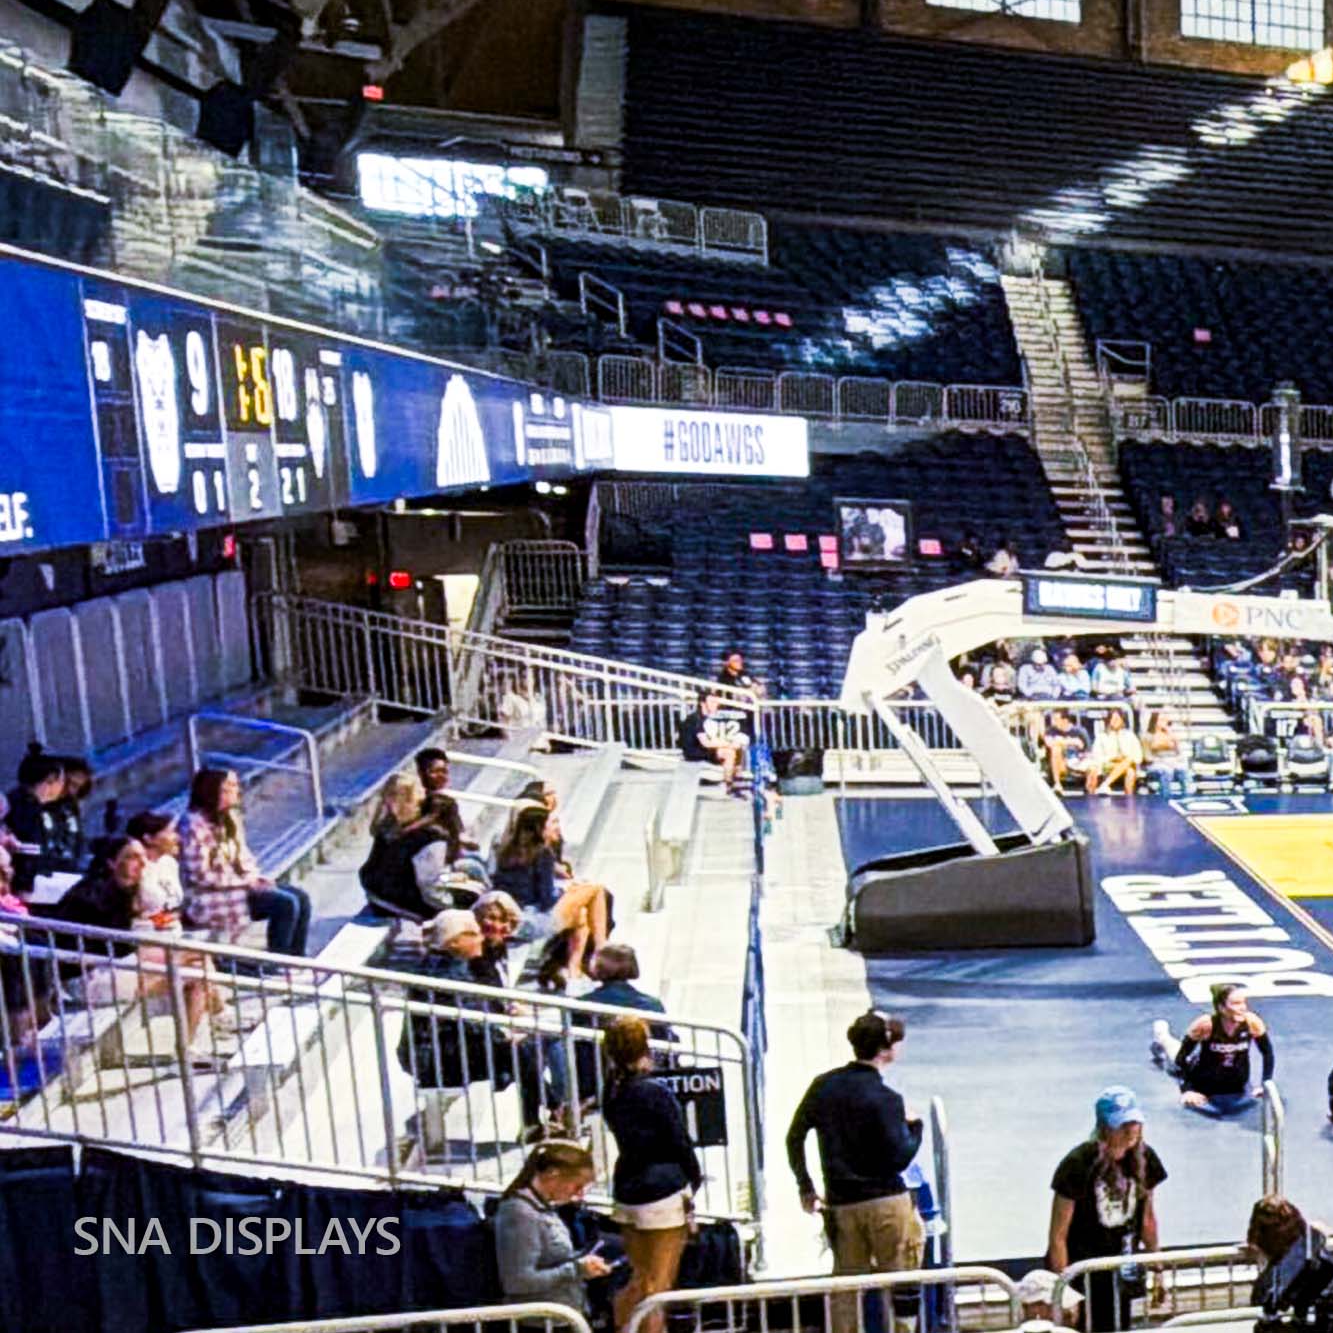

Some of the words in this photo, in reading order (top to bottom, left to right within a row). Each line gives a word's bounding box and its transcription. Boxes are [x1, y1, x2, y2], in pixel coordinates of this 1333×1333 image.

[186, 331, 209, 416] 9
[273, 348, 297, 421] 18
[248, 469, 263, 511] 2
